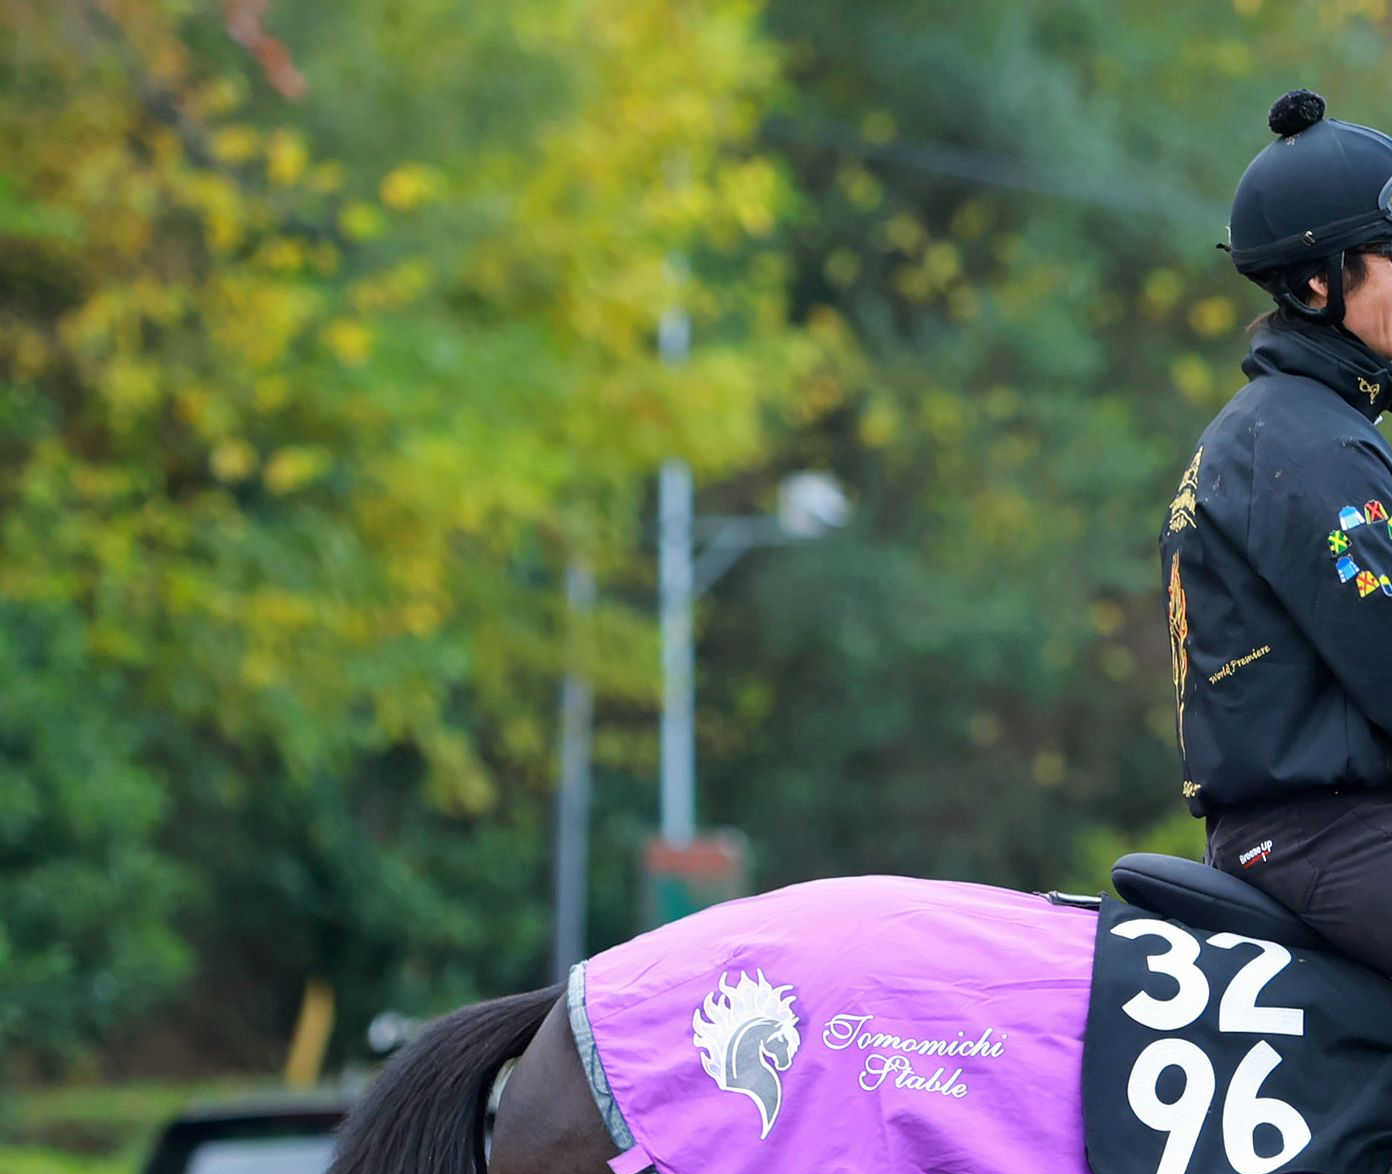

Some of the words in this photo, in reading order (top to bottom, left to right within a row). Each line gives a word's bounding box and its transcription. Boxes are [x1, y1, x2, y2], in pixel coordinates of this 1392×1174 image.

[1230, 645, 1271, 673] Premiere
[1110, 919, 1304, 1036] 32
[822, 1013, 1008, 1058] Tomomichi
[858, 1053, 969, 1099] Stable
